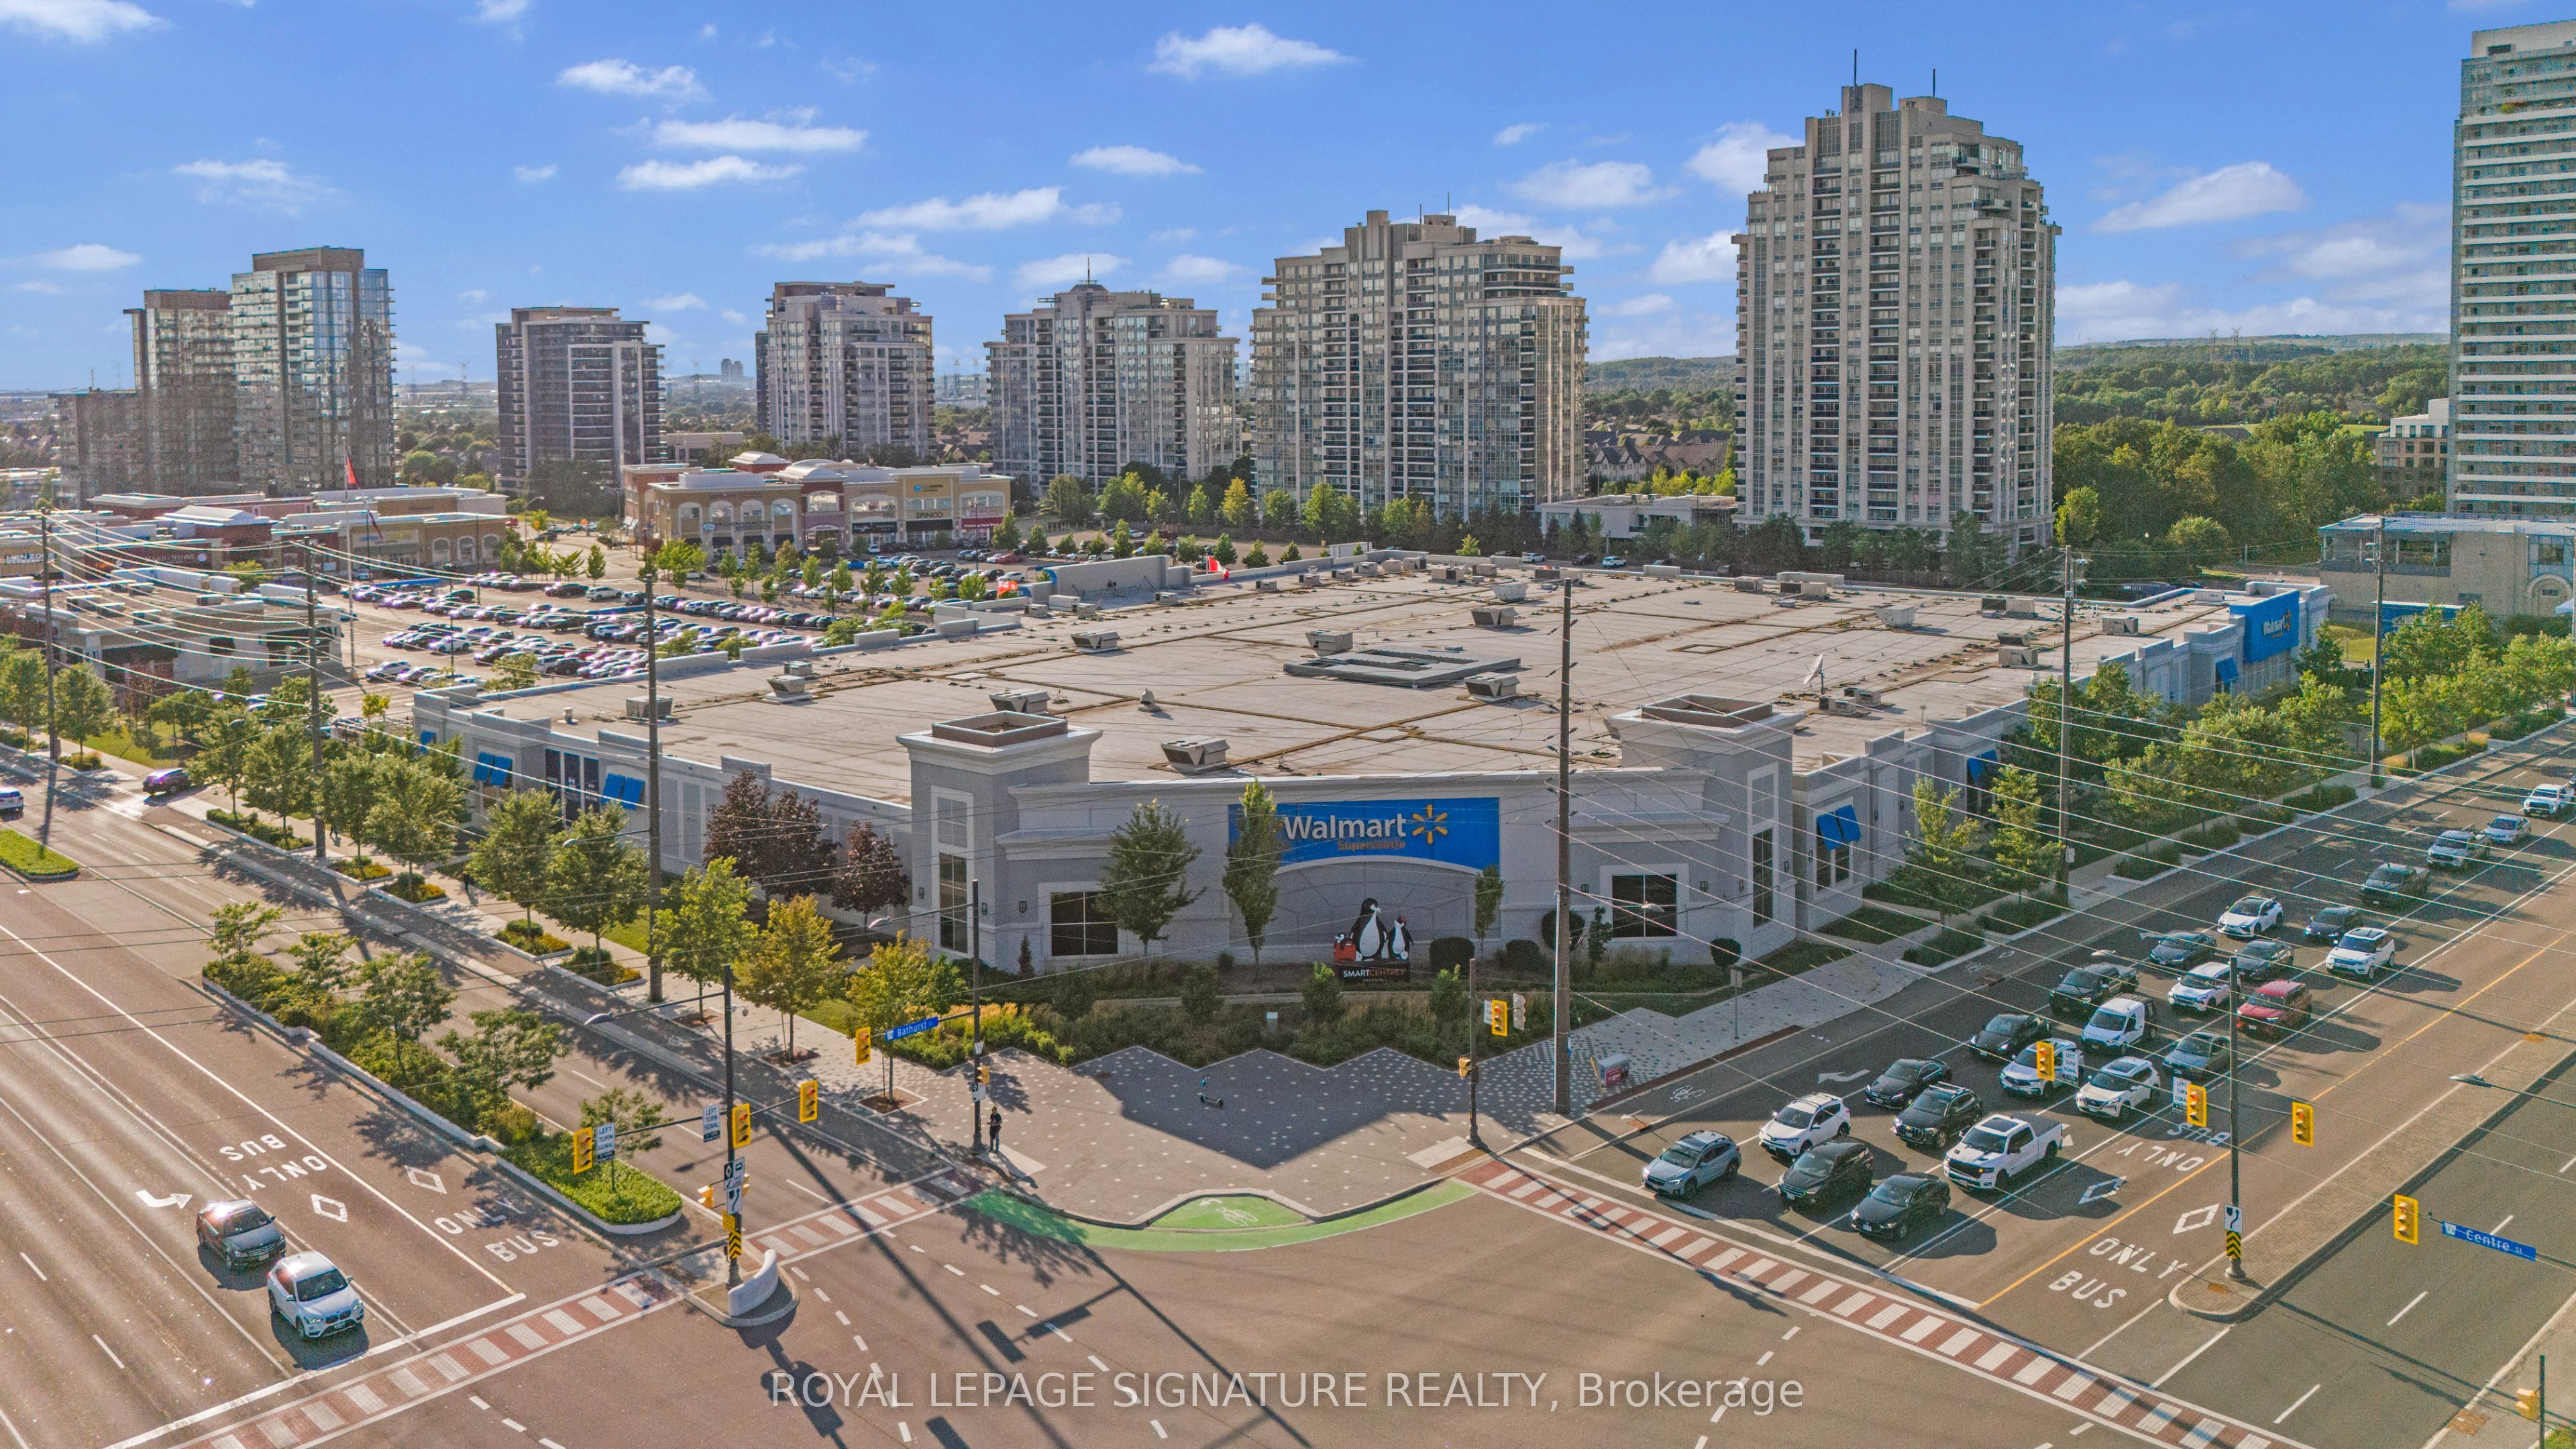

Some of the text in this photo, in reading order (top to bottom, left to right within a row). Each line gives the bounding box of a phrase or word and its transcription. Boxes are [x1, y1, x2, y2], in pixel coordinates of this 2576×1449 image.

[2263, 614, 2286, 635] Walmart
[1284, 813, 1407, 840] Walmart
[1343, 969, 1406, 977] SMARTCENTRES
[898, 1021, 927, 1037] Bathurst
[706, 1107, 717, 1116] LEFT
[598, 1126, 612, 1134] LEFT
[704, 1123, 720, 1131] SIGNAL
[219, 1133, 286, 1162] BUS
[598, 1142, 613, 1150] SIGNAL
[2116, 1141, 2204, 1171] ONLY
[241, 1155, 327, 1191] ONLY
[435, 1197, 526, 1234] ONLY
[484, 1230, 559, 1263] BUS
[2466, 1229, 2510, 1252] Centre
[2089, 1237, 2189, 1279] ONLY
[2047, 1270, 2127, 1308] BUS
